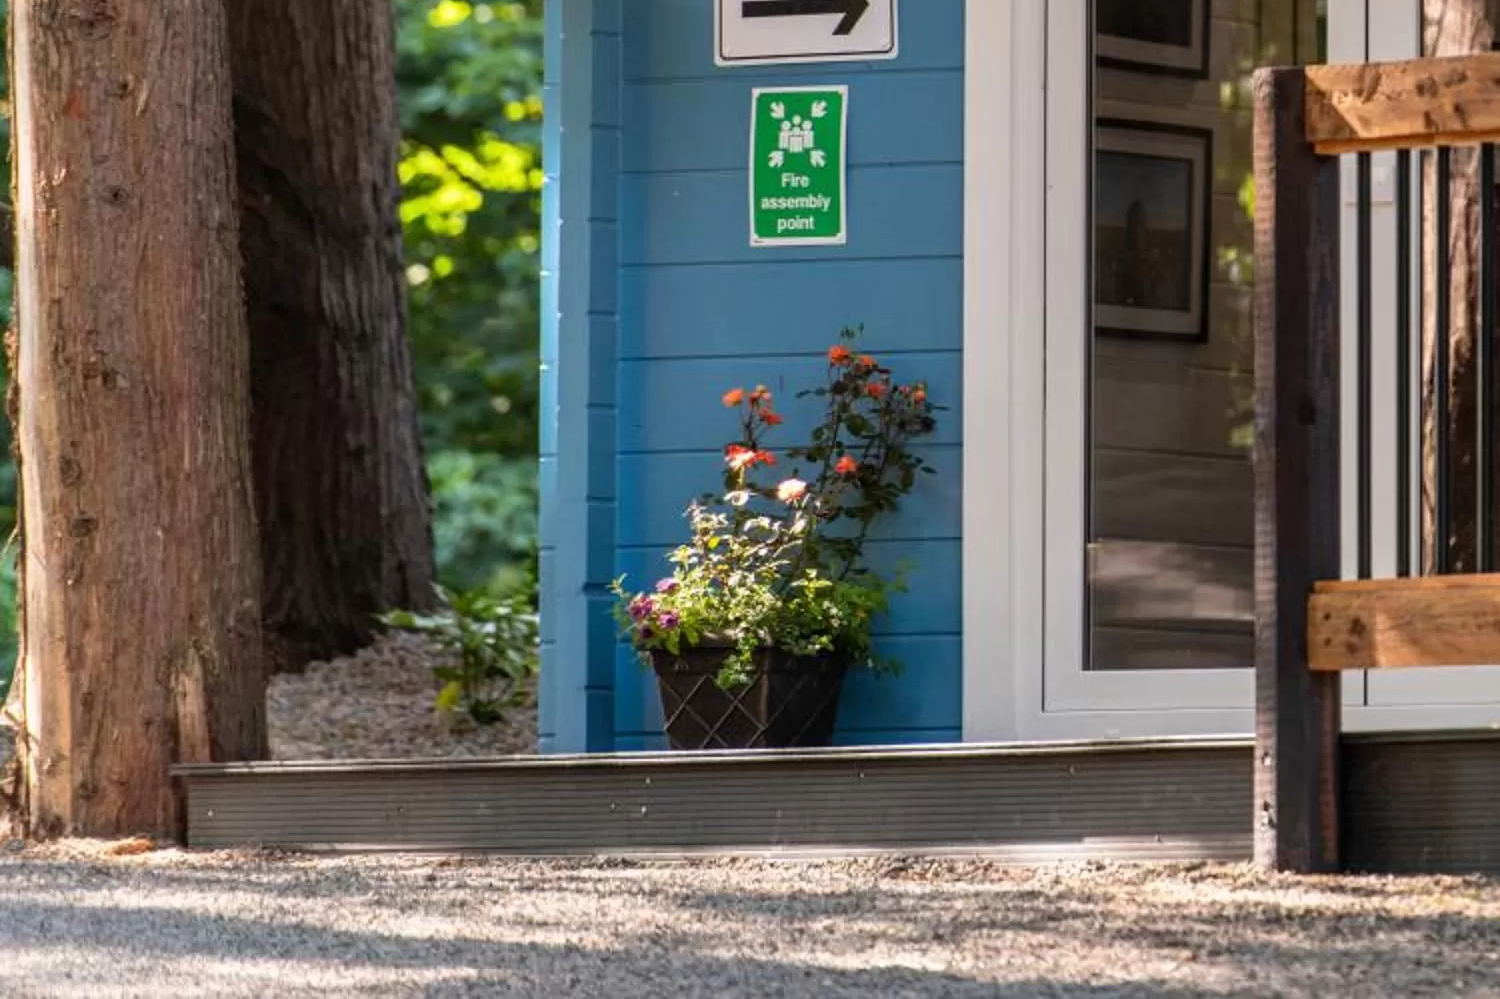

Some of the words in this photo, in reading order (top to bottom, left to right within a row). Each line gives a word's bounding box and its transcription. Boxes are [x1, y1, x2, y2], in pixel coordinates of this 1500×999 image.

[780, 172, 811, 188] Fire
[760, 193, 833, 212] assembly
[776, 215, 816, 234] point
